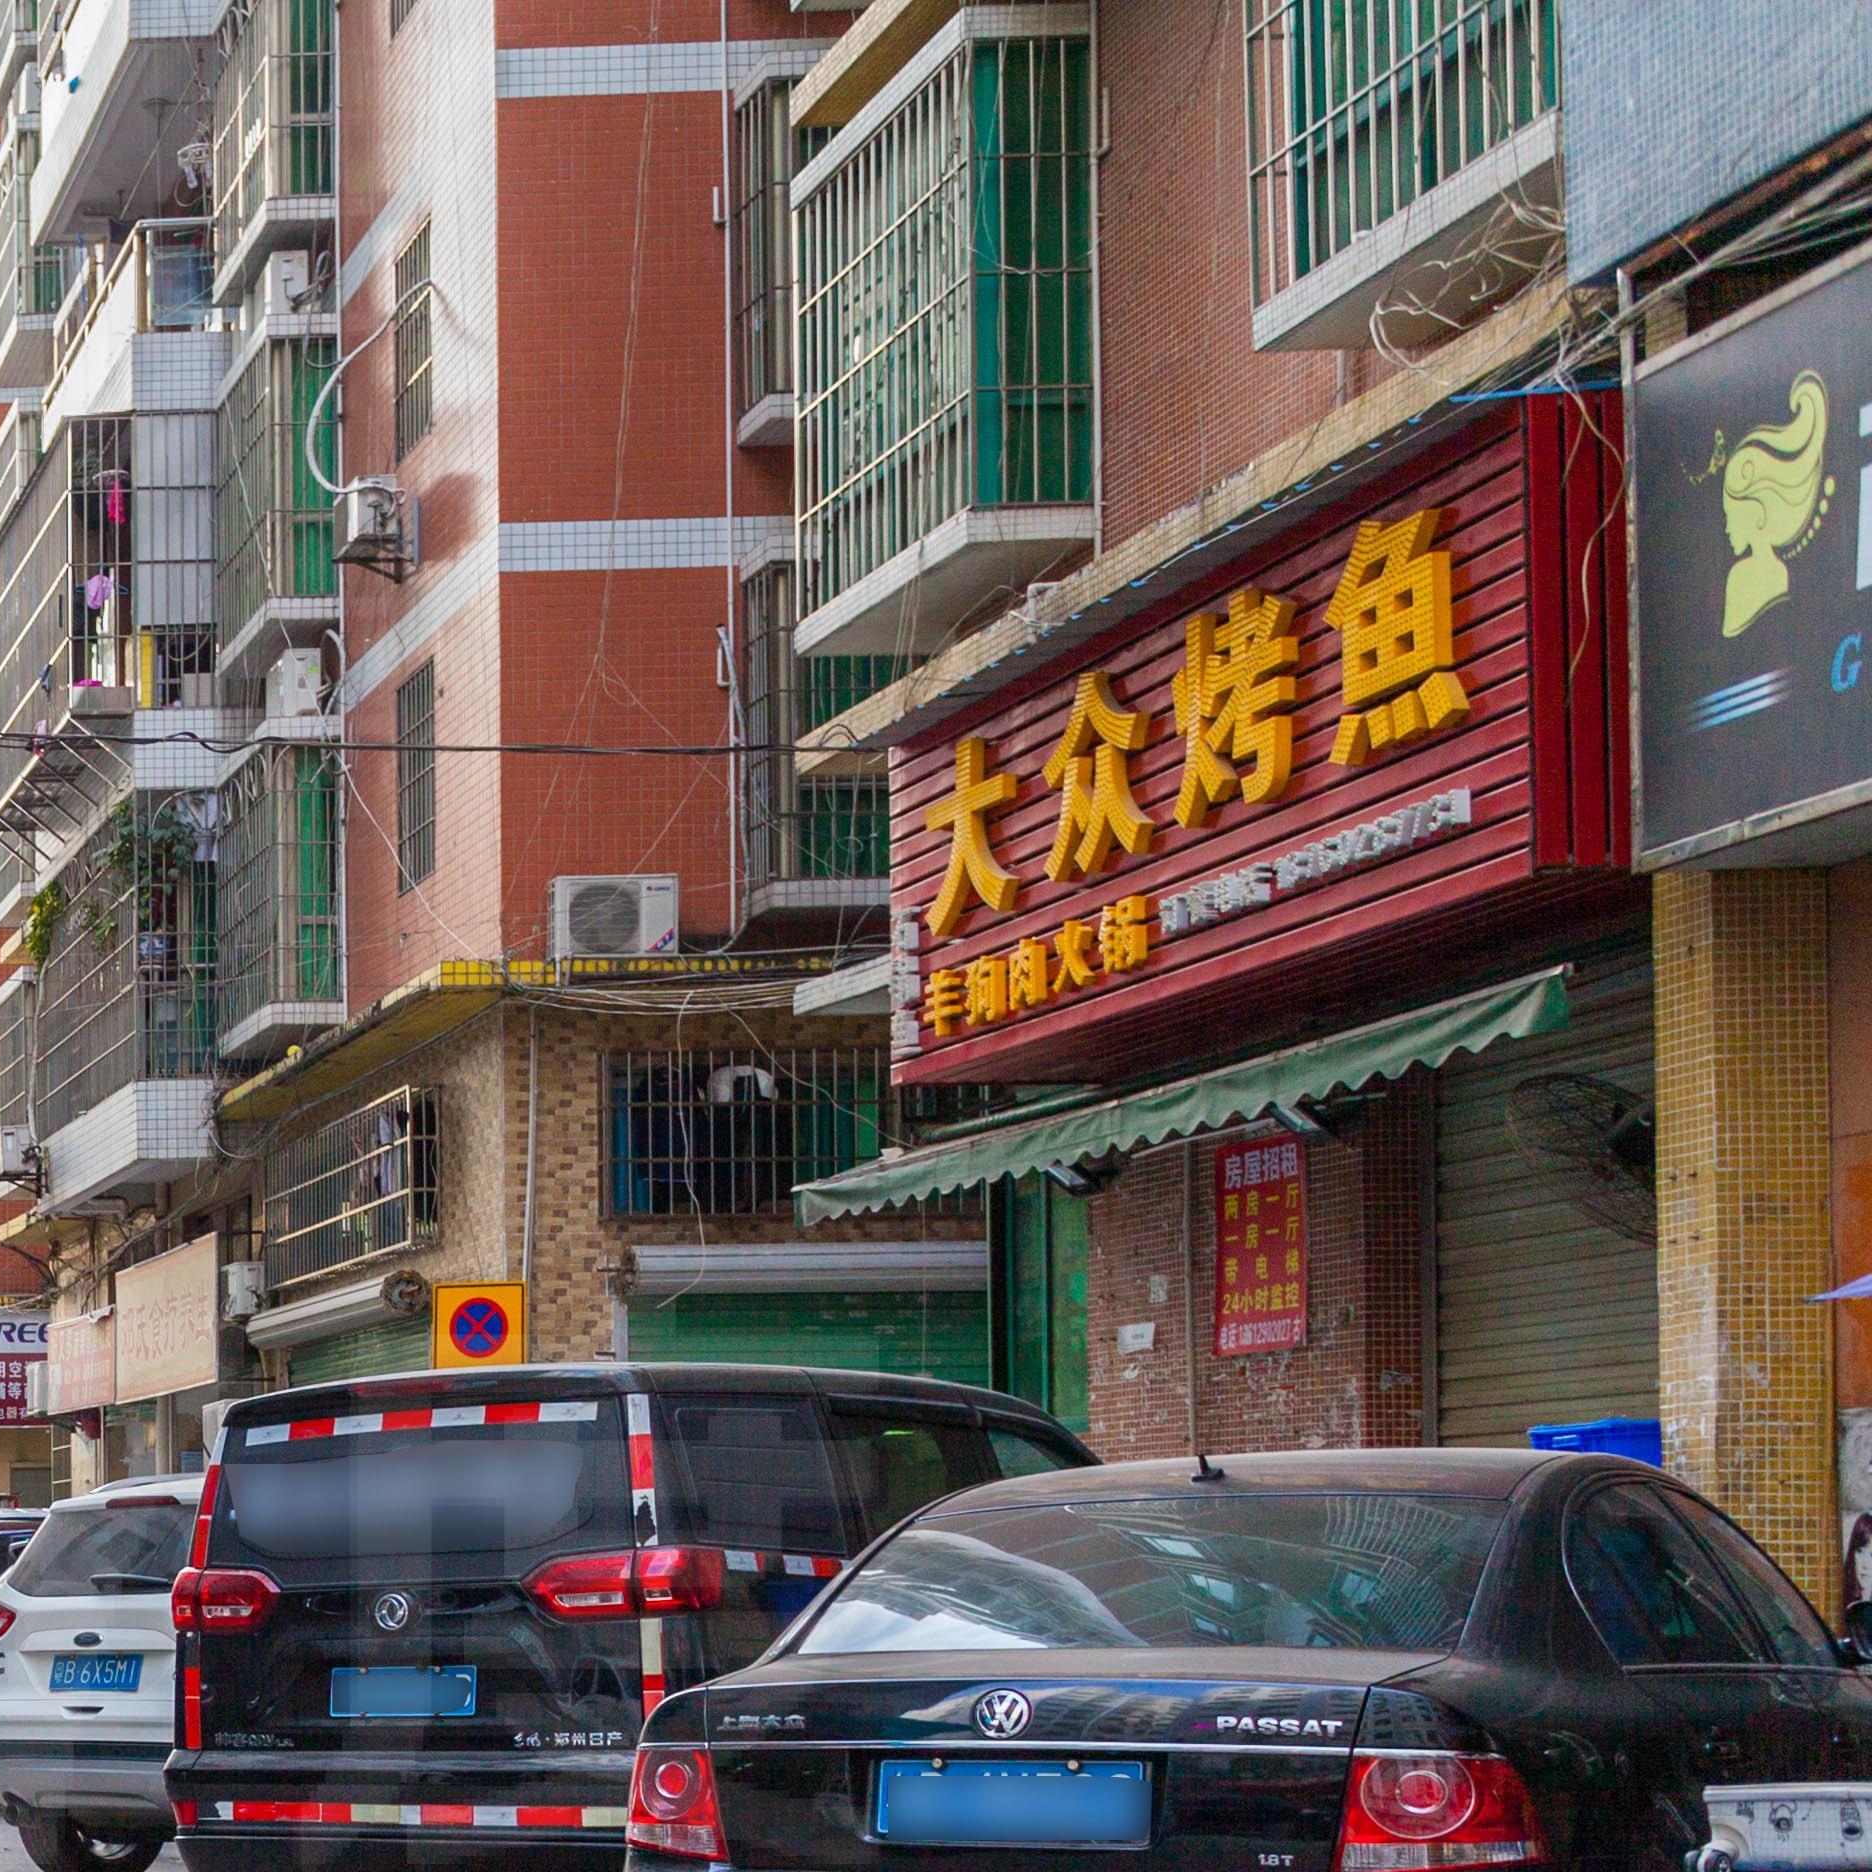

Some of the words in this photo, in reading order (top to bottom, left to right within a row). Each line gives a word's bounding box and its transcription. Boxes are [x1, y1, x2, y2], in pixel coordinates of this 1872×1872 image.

[1224, 1143, 1298, 1189] 房屋招租
[1224, 1182, 1299, 1220] 两房一厅
[1225, 1215, 1299, 1248] 一房一厅
[1222, 1281, 1299, 1315] 24小时监控
[1216, 1715, 1343, 1738] PASSAT
